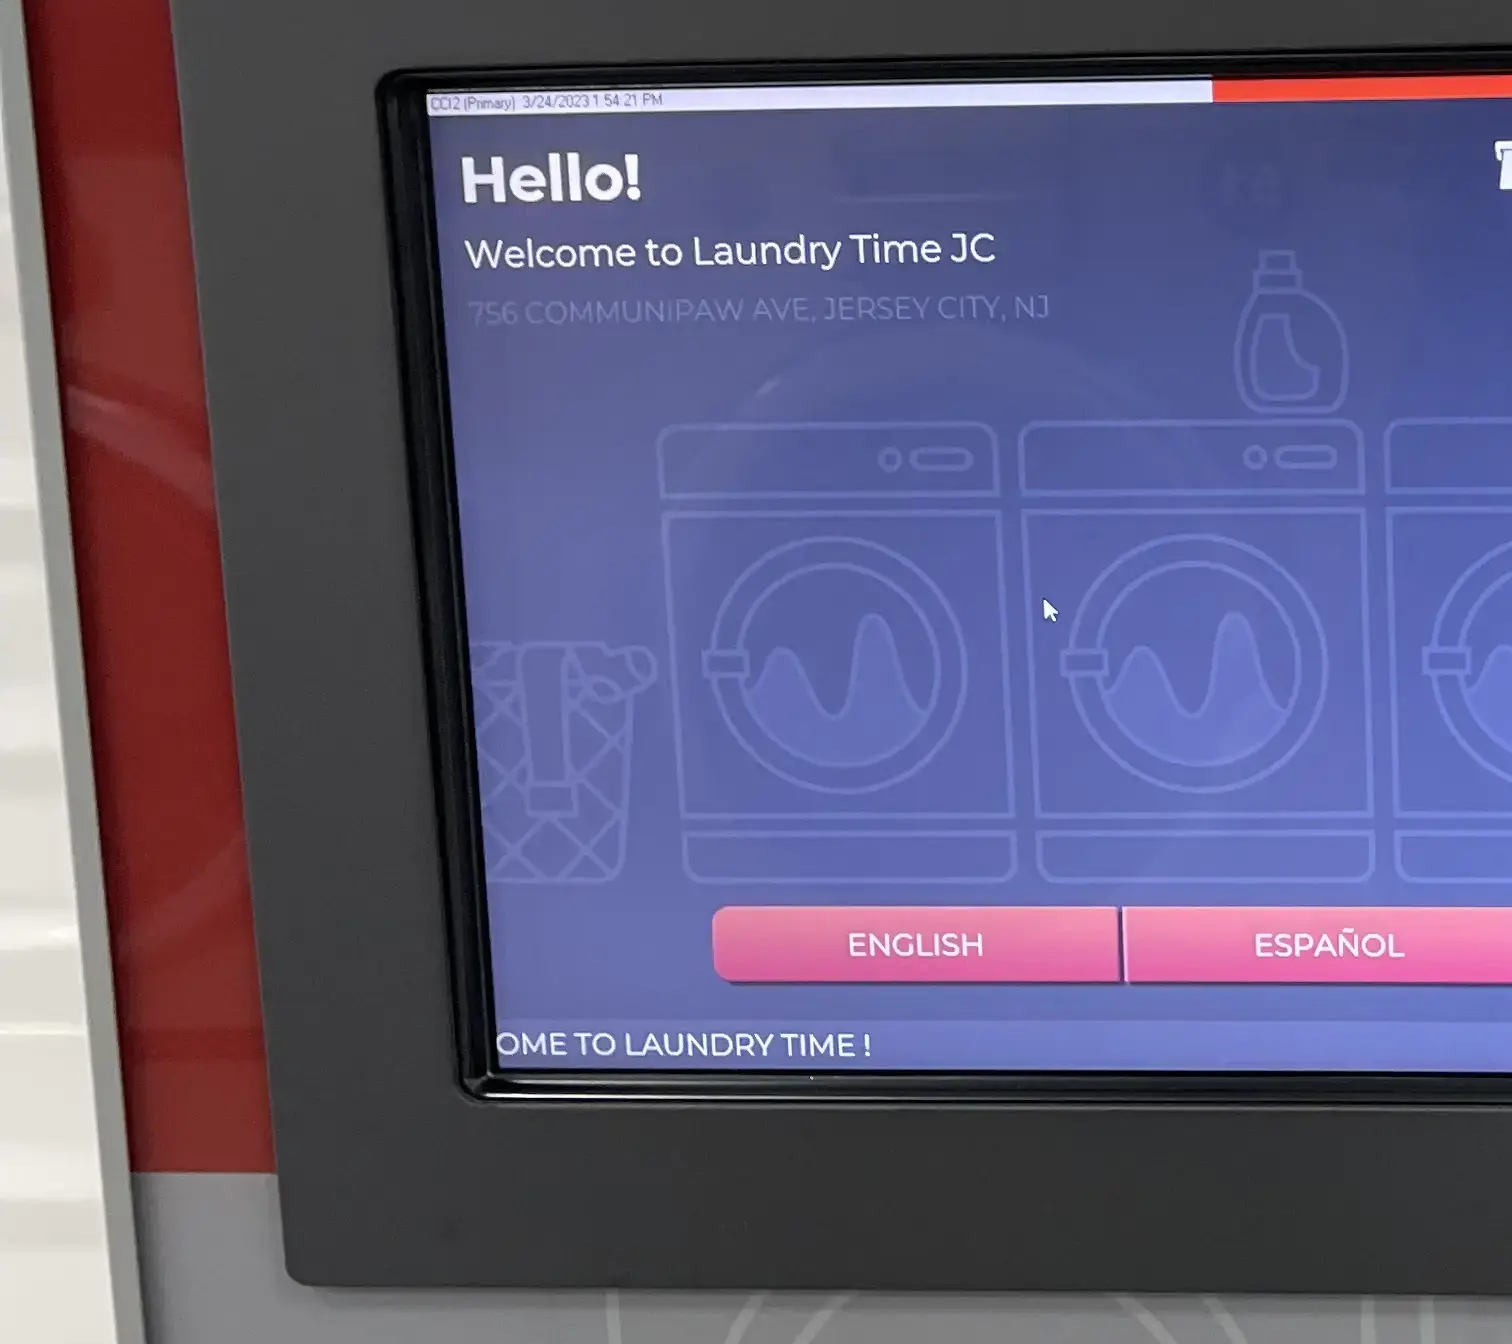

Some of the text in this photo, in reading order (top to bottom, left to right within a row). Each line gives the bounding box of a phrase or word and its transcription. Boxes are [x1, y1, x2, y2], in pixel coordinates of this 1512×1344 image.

[522, 94, 589, 109] 3/24/2023
[642, 92, 663, 106] PM
[460, 152, 641, 203] Hello!
[464, 232, 996, 271] Welcome to Laundry Time JC
[468, 302, 518, 326] 756
[524, 298, 743, 325] COMMUNIPAW
[823, 296, 929, 321] JERSEY
[938, 295, 1005, 323] CITY,
[1016, 295, 1049, 320] NJ
[847, 926, 1405, 960] ENGLISH ESPAÑOL
[496, 1031, 567, 1056] OME
[574, 1031, 616, 1057] TO
[625, 1032, 774, 1058] LAUNDRY
[781, 1032, 855, 1057] TIME
